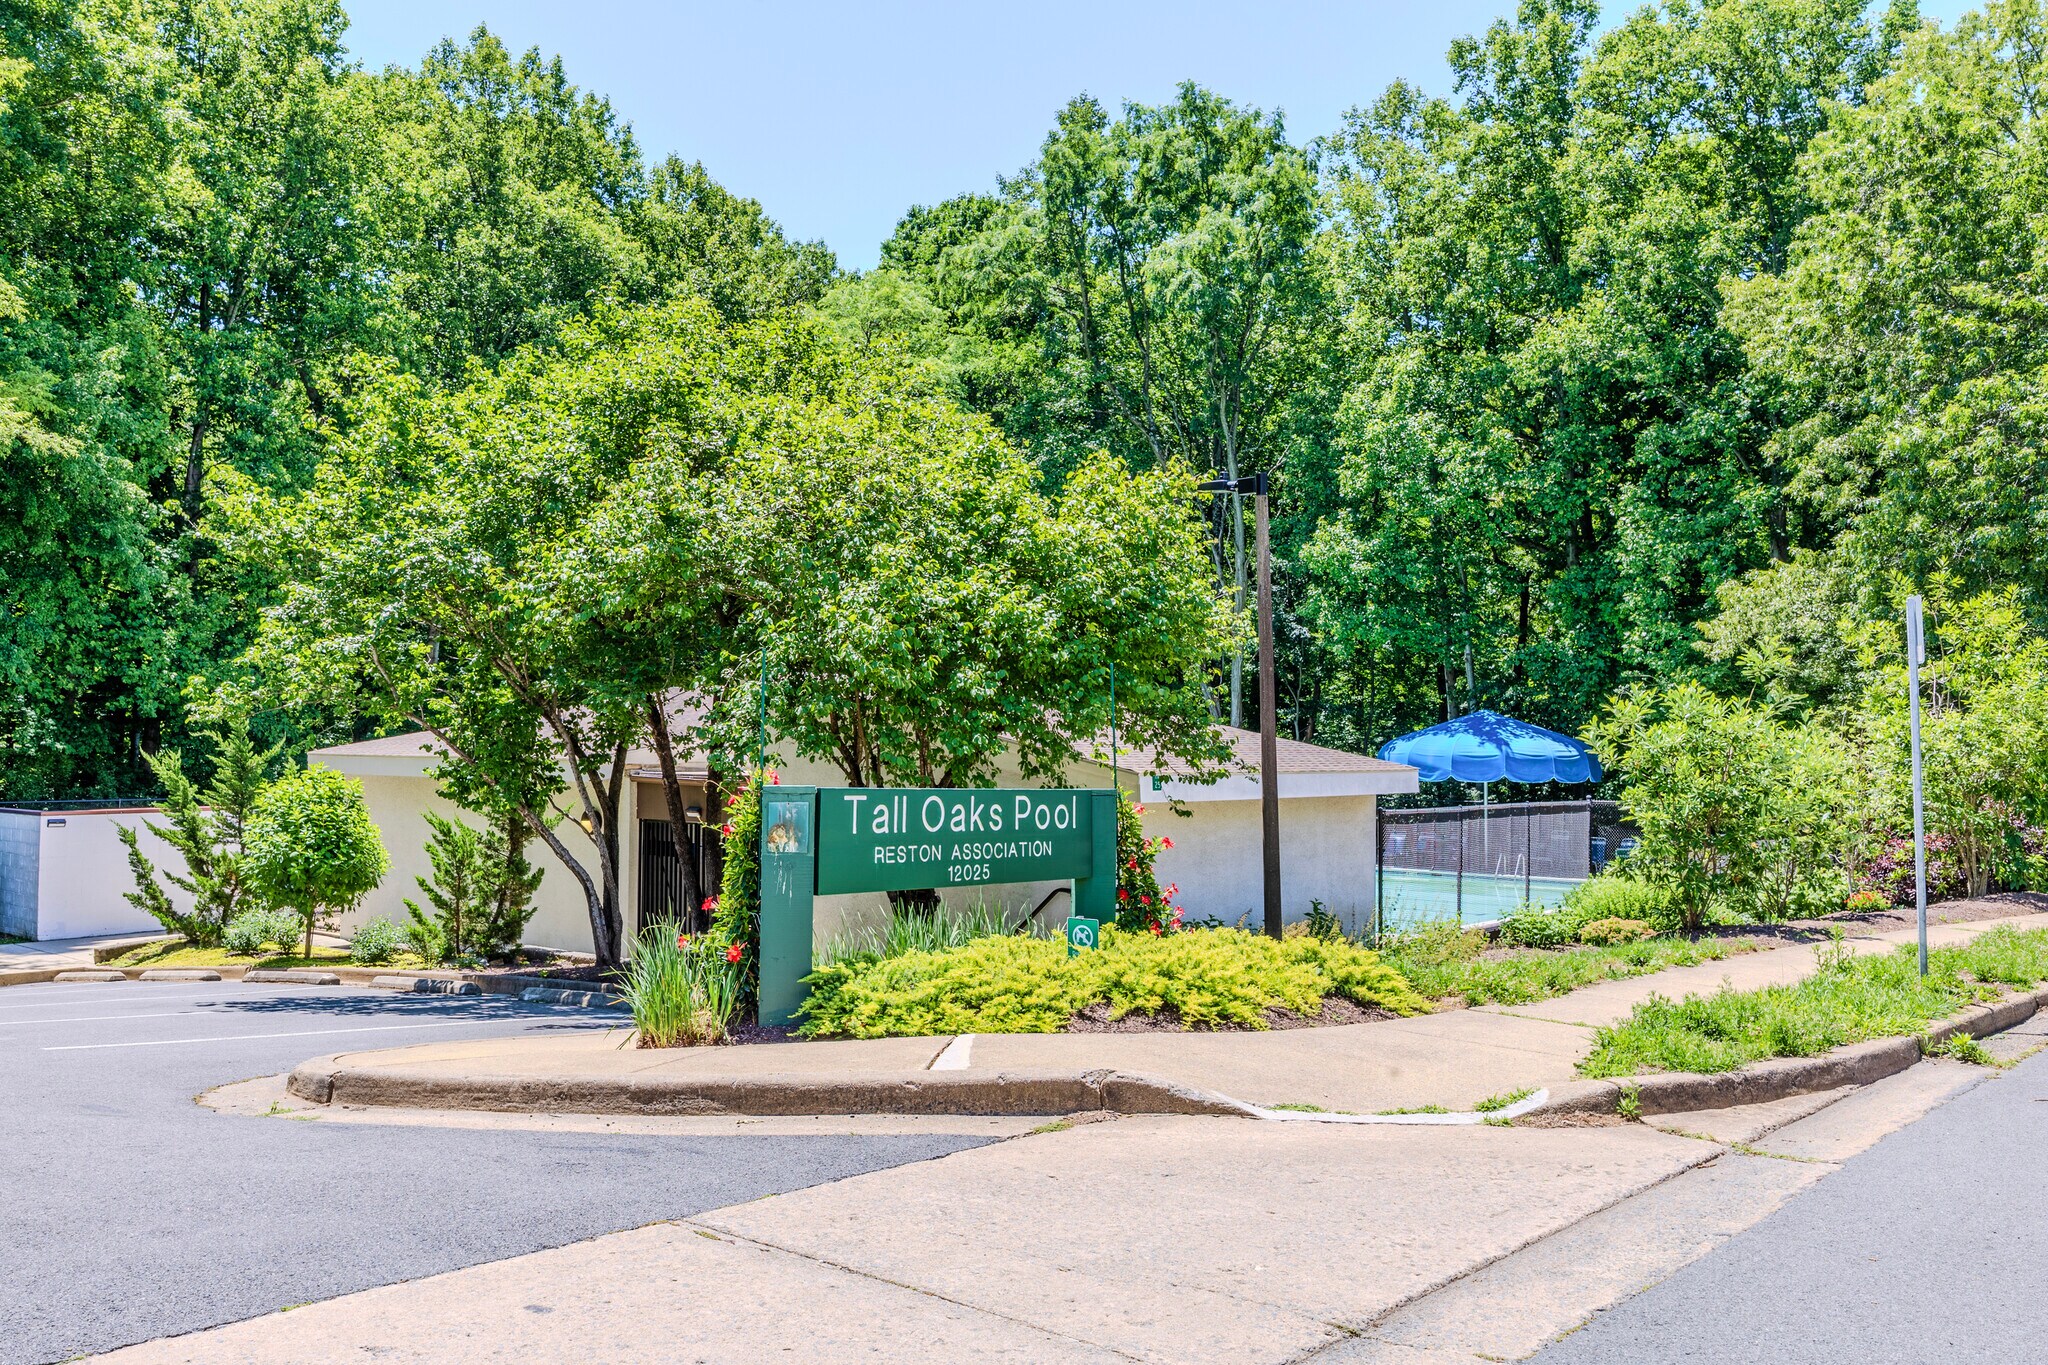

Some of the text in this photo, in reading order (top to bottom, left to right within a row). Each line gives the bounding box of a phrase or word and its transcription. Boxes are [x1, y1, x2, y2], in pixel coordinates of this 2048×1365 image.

[843, 794, 1077, 835] Tall Oaks Pool
[873, 840, 1052, 864] RESTON ASSOCIATION
[947, 863, 990, 882] 12025
